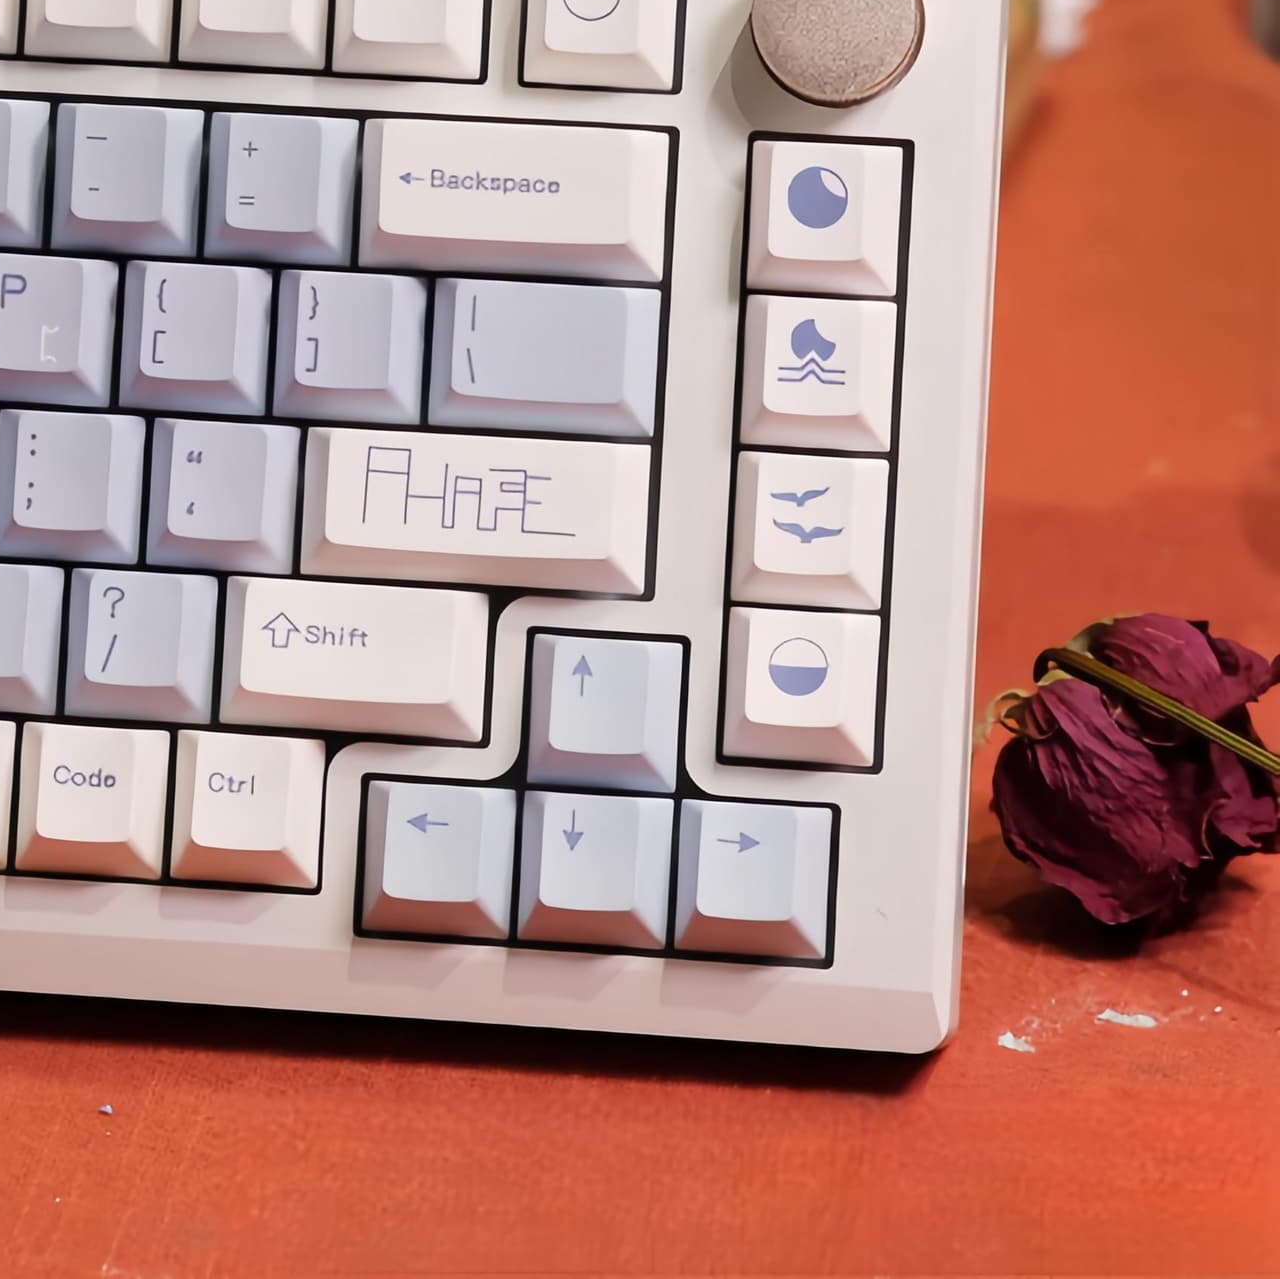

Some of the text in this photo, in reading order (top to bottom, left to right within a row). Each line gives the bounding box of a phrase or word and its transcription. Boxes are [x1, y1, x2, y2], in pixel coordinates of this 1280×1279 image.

[430, 168, 561, 195] Backspace
[0, 273, 28, 309] P
[304, 625, 369, 648] Shift
[53, 764, 117, 789] Code
[208, 772, 255, 796] Ctrl
